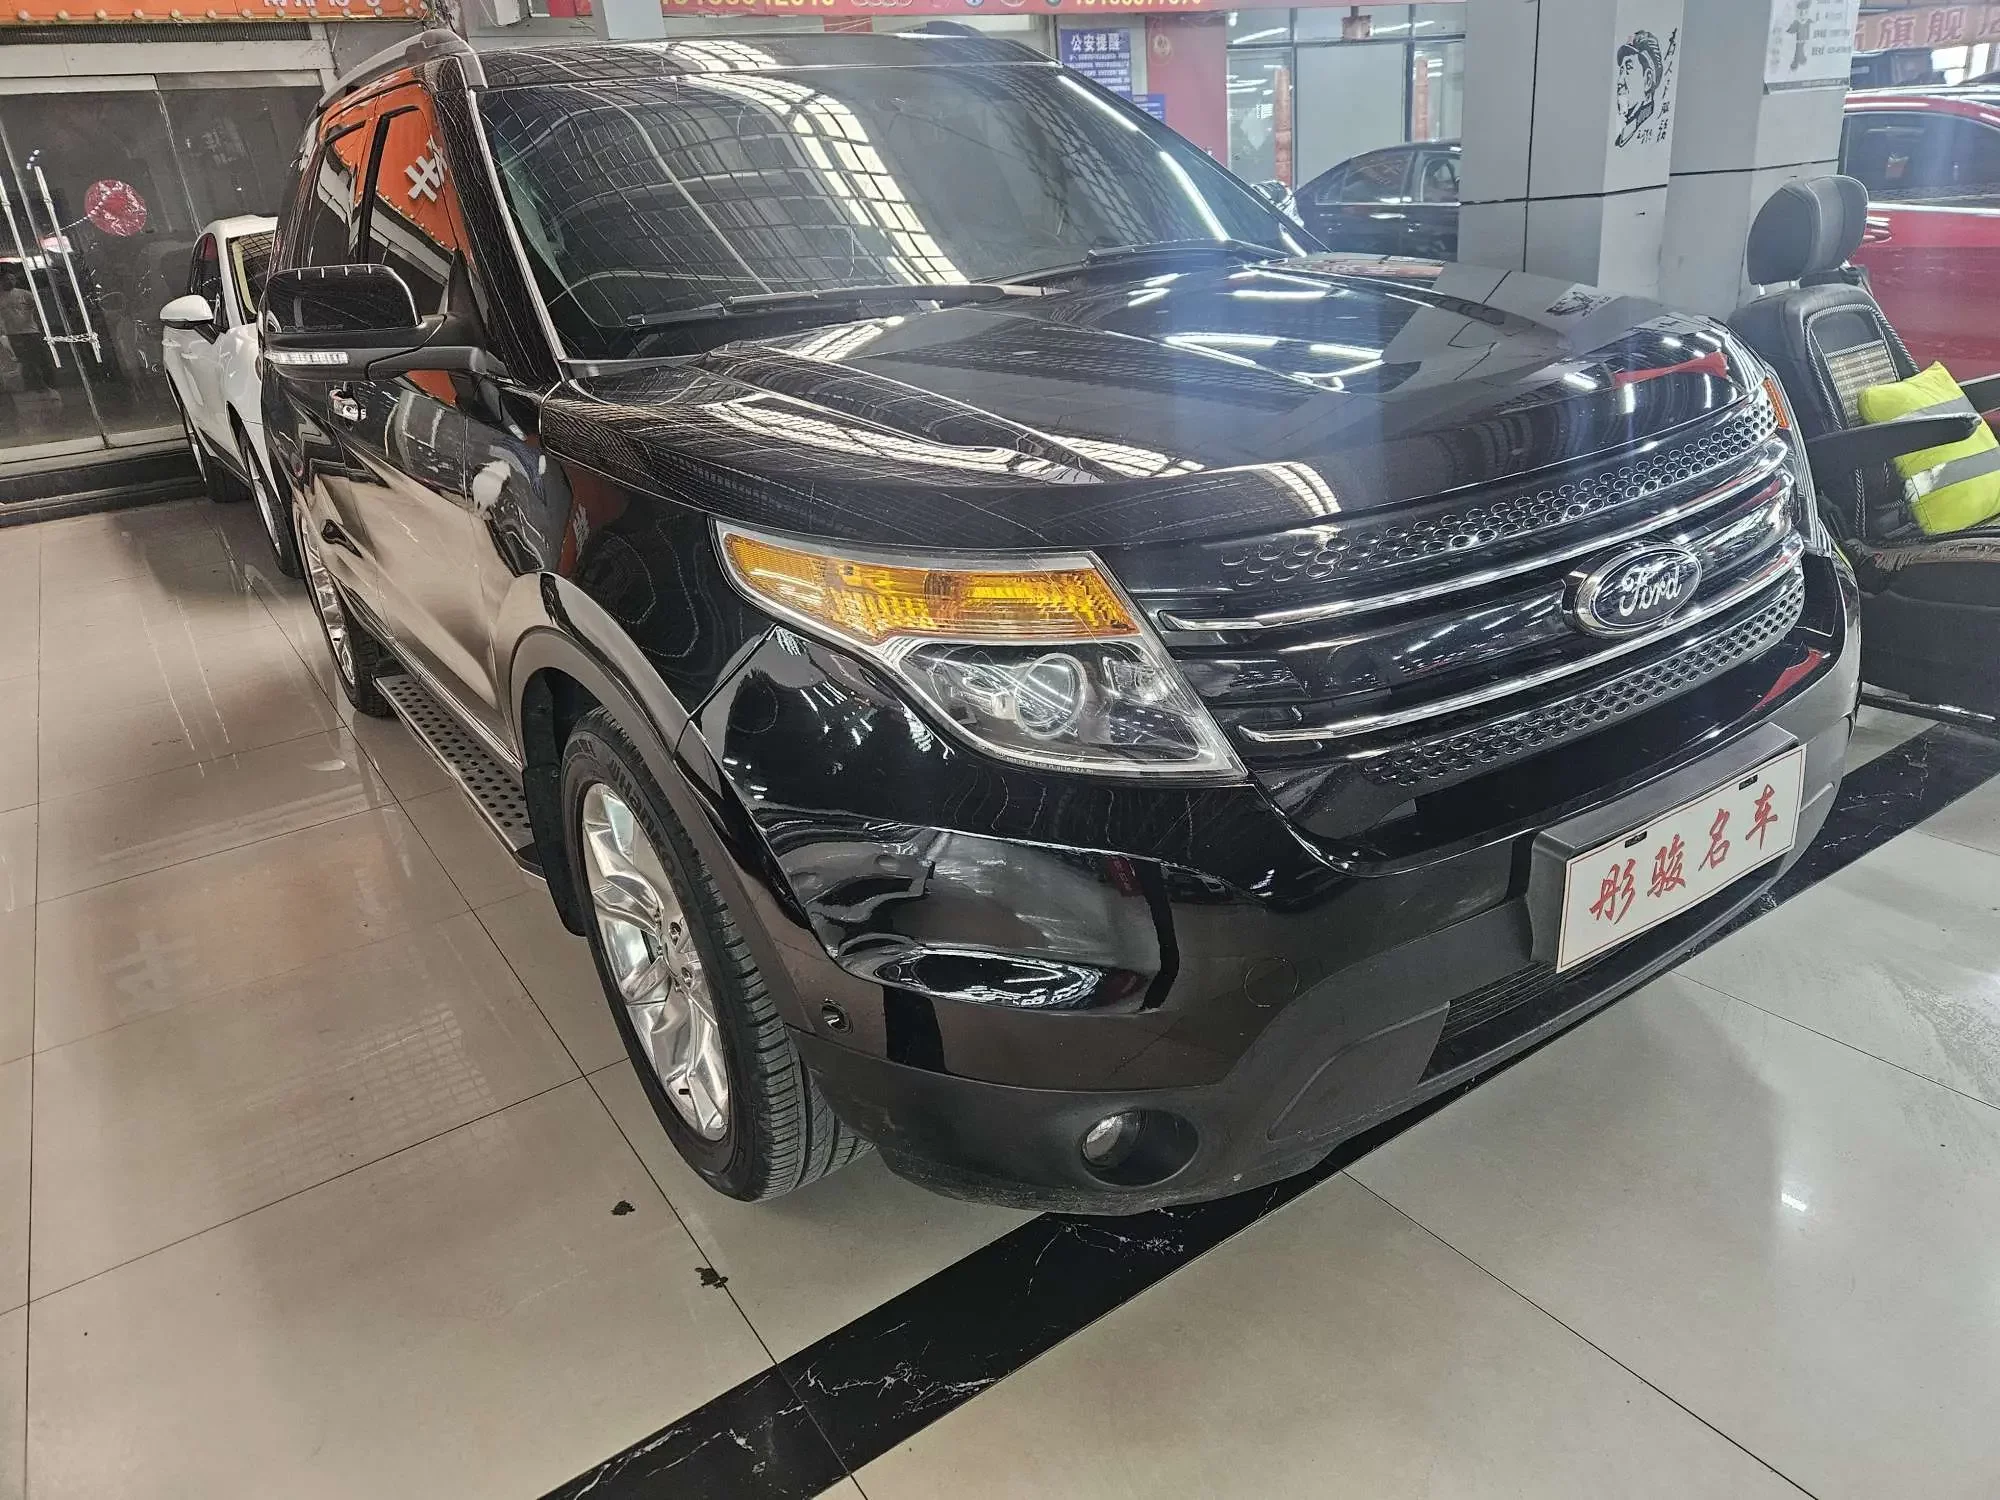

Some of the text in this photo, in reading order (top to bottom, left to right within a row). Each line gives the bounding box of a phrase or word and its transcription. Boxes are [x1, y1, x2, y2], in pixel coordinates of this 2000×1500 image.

[1070, 32, 1121, 53] 公安提醒
[1618, 560, 1683, 618] Ford
[1588, 783, 1779, 926] 彤骏名车
